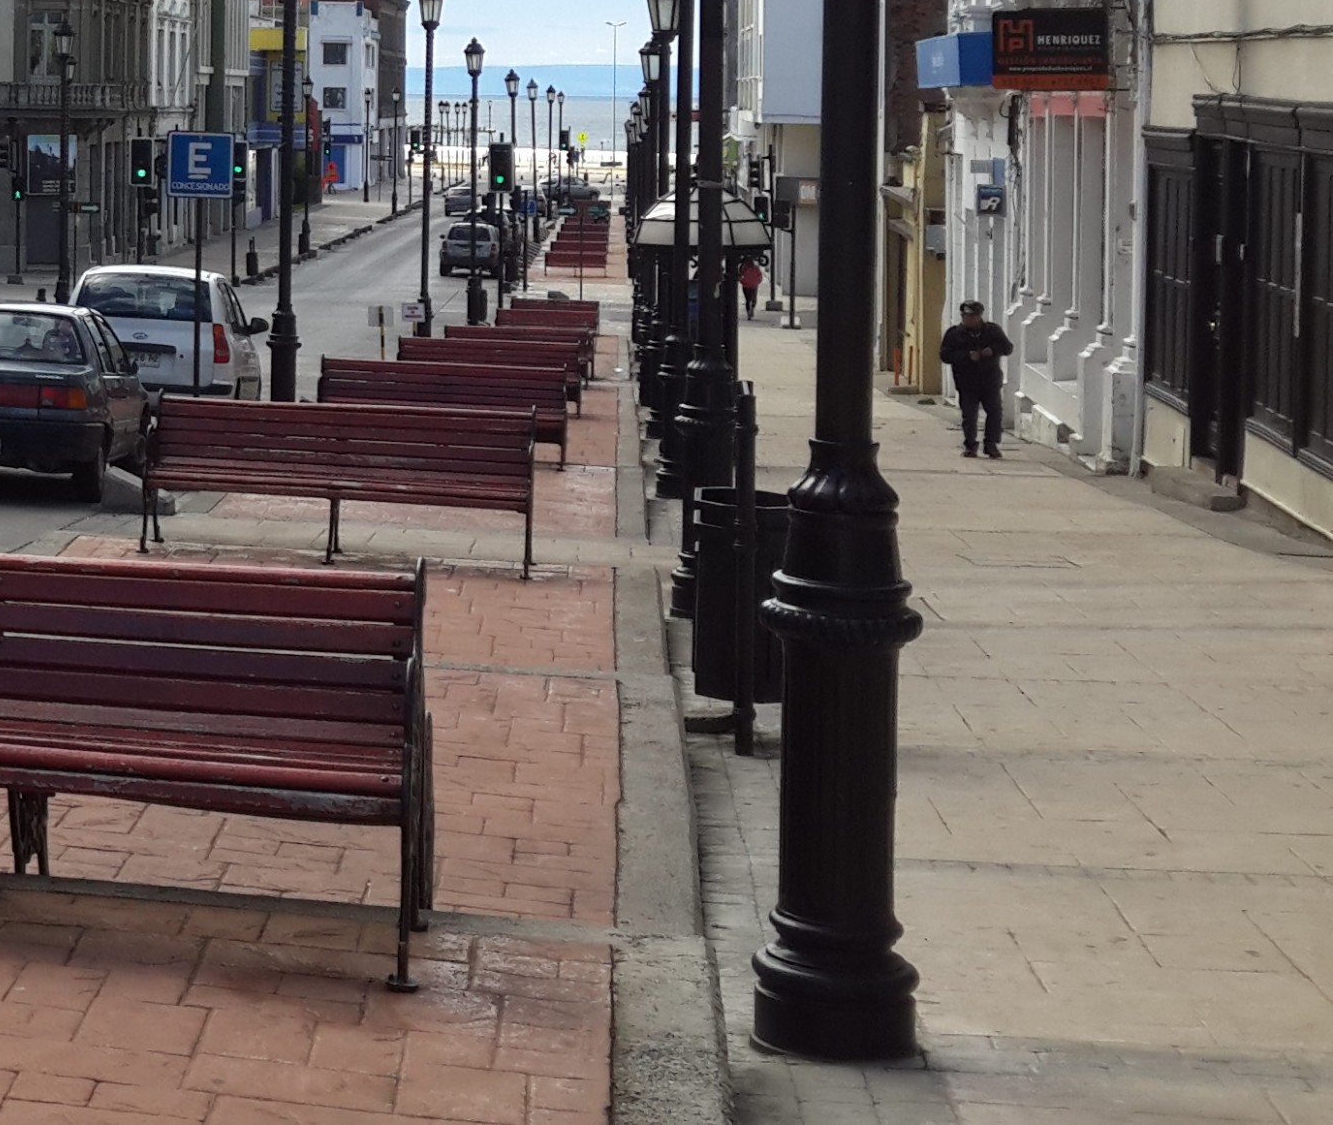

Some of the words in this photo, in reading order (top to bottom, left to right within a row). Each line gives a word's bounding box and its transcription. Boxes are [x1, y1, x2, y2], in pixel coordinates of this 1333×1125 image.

[1037, 35, 1102, 46] HENRIQUEZ
[188, 142, 212, 175] E
[171, 181, 231, 191] CONCESIONADO
